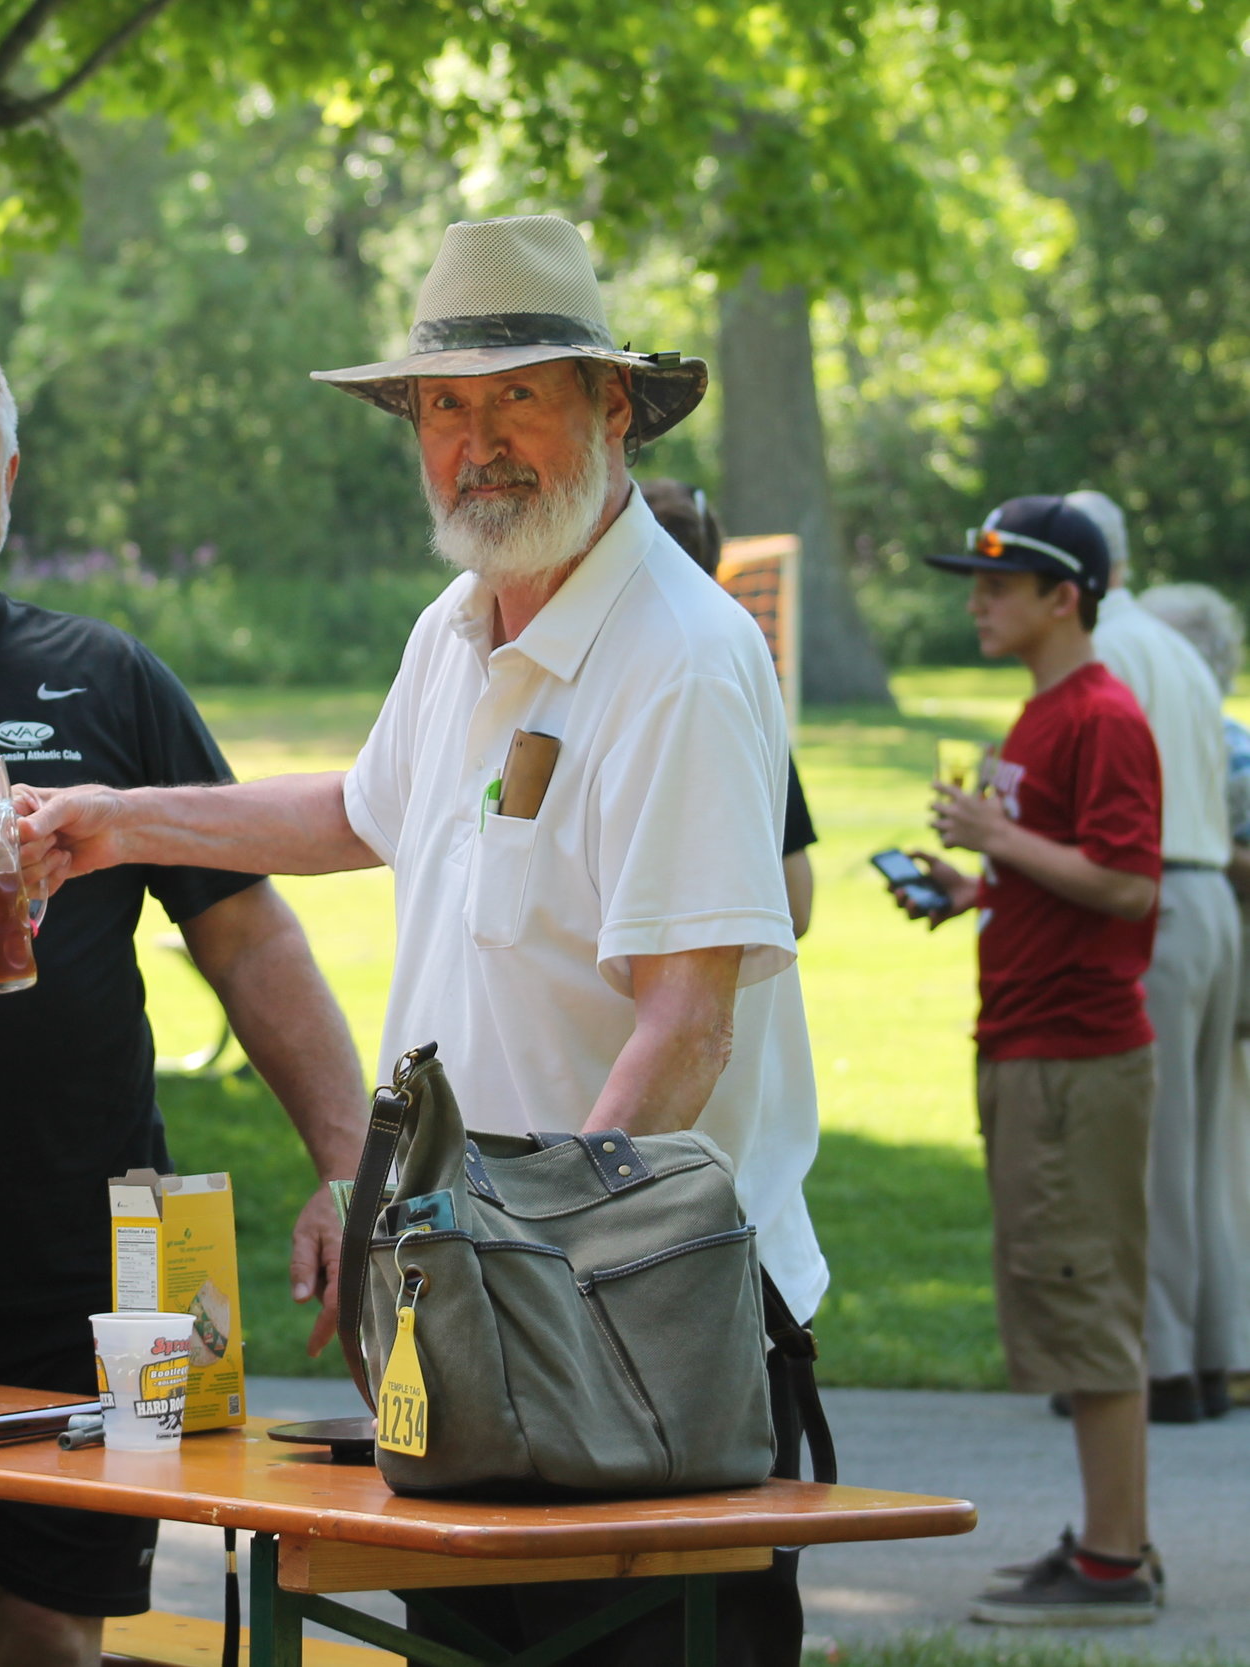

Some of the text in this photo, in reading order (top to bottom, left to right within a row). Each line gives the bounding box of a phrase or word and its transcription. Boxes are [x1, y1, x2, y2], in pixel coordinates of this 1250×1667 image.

[0, 725, 50, 740] WAC
[26, 750, 62, 760] Athletic
[62, 749, 82, 761] Club
[388, 1382, 421, 1397] TEMPLE TAG
[135, 1399, 169, 1416] HARD
[380, 1393, 425, 1449] 1234
